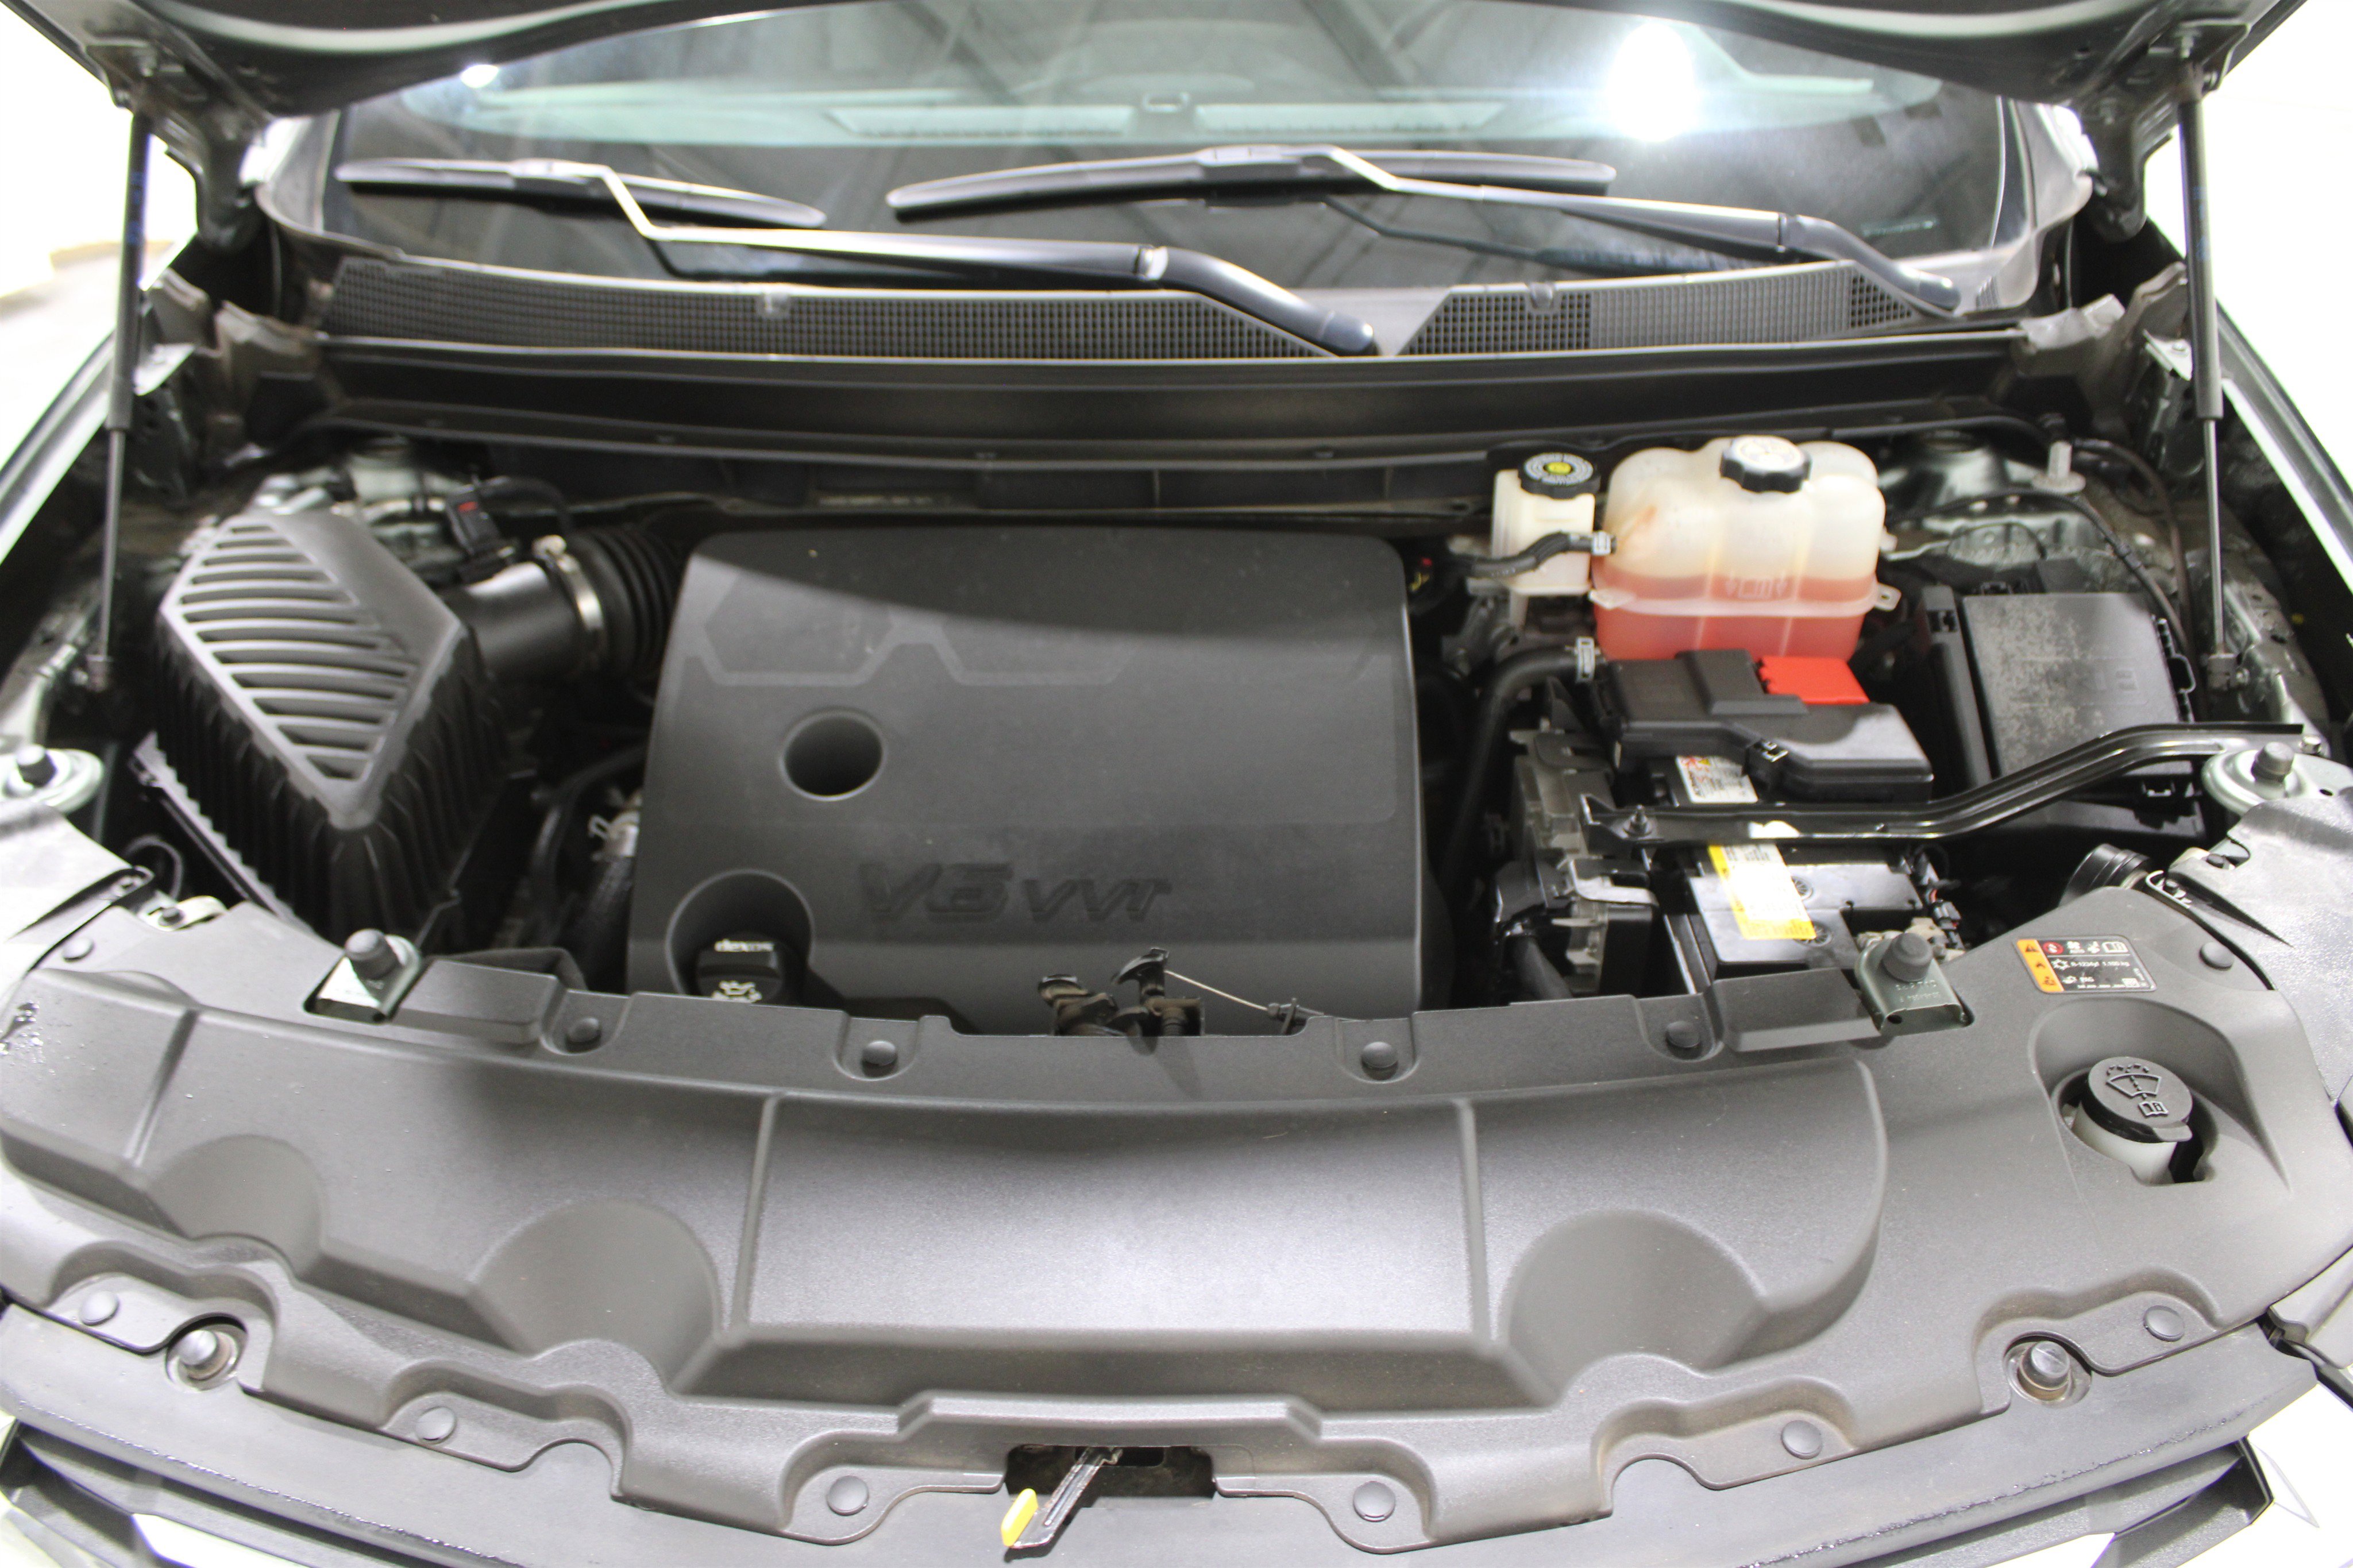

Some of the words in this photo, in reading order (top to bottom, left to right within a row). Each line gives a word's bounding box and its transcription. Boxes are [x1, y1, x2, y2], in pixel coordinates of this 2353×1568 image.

[859, 863, 1013, 922] V6
[1022, 878, 1173, 922] VVT
[715, 939, 774, 953] dexos
